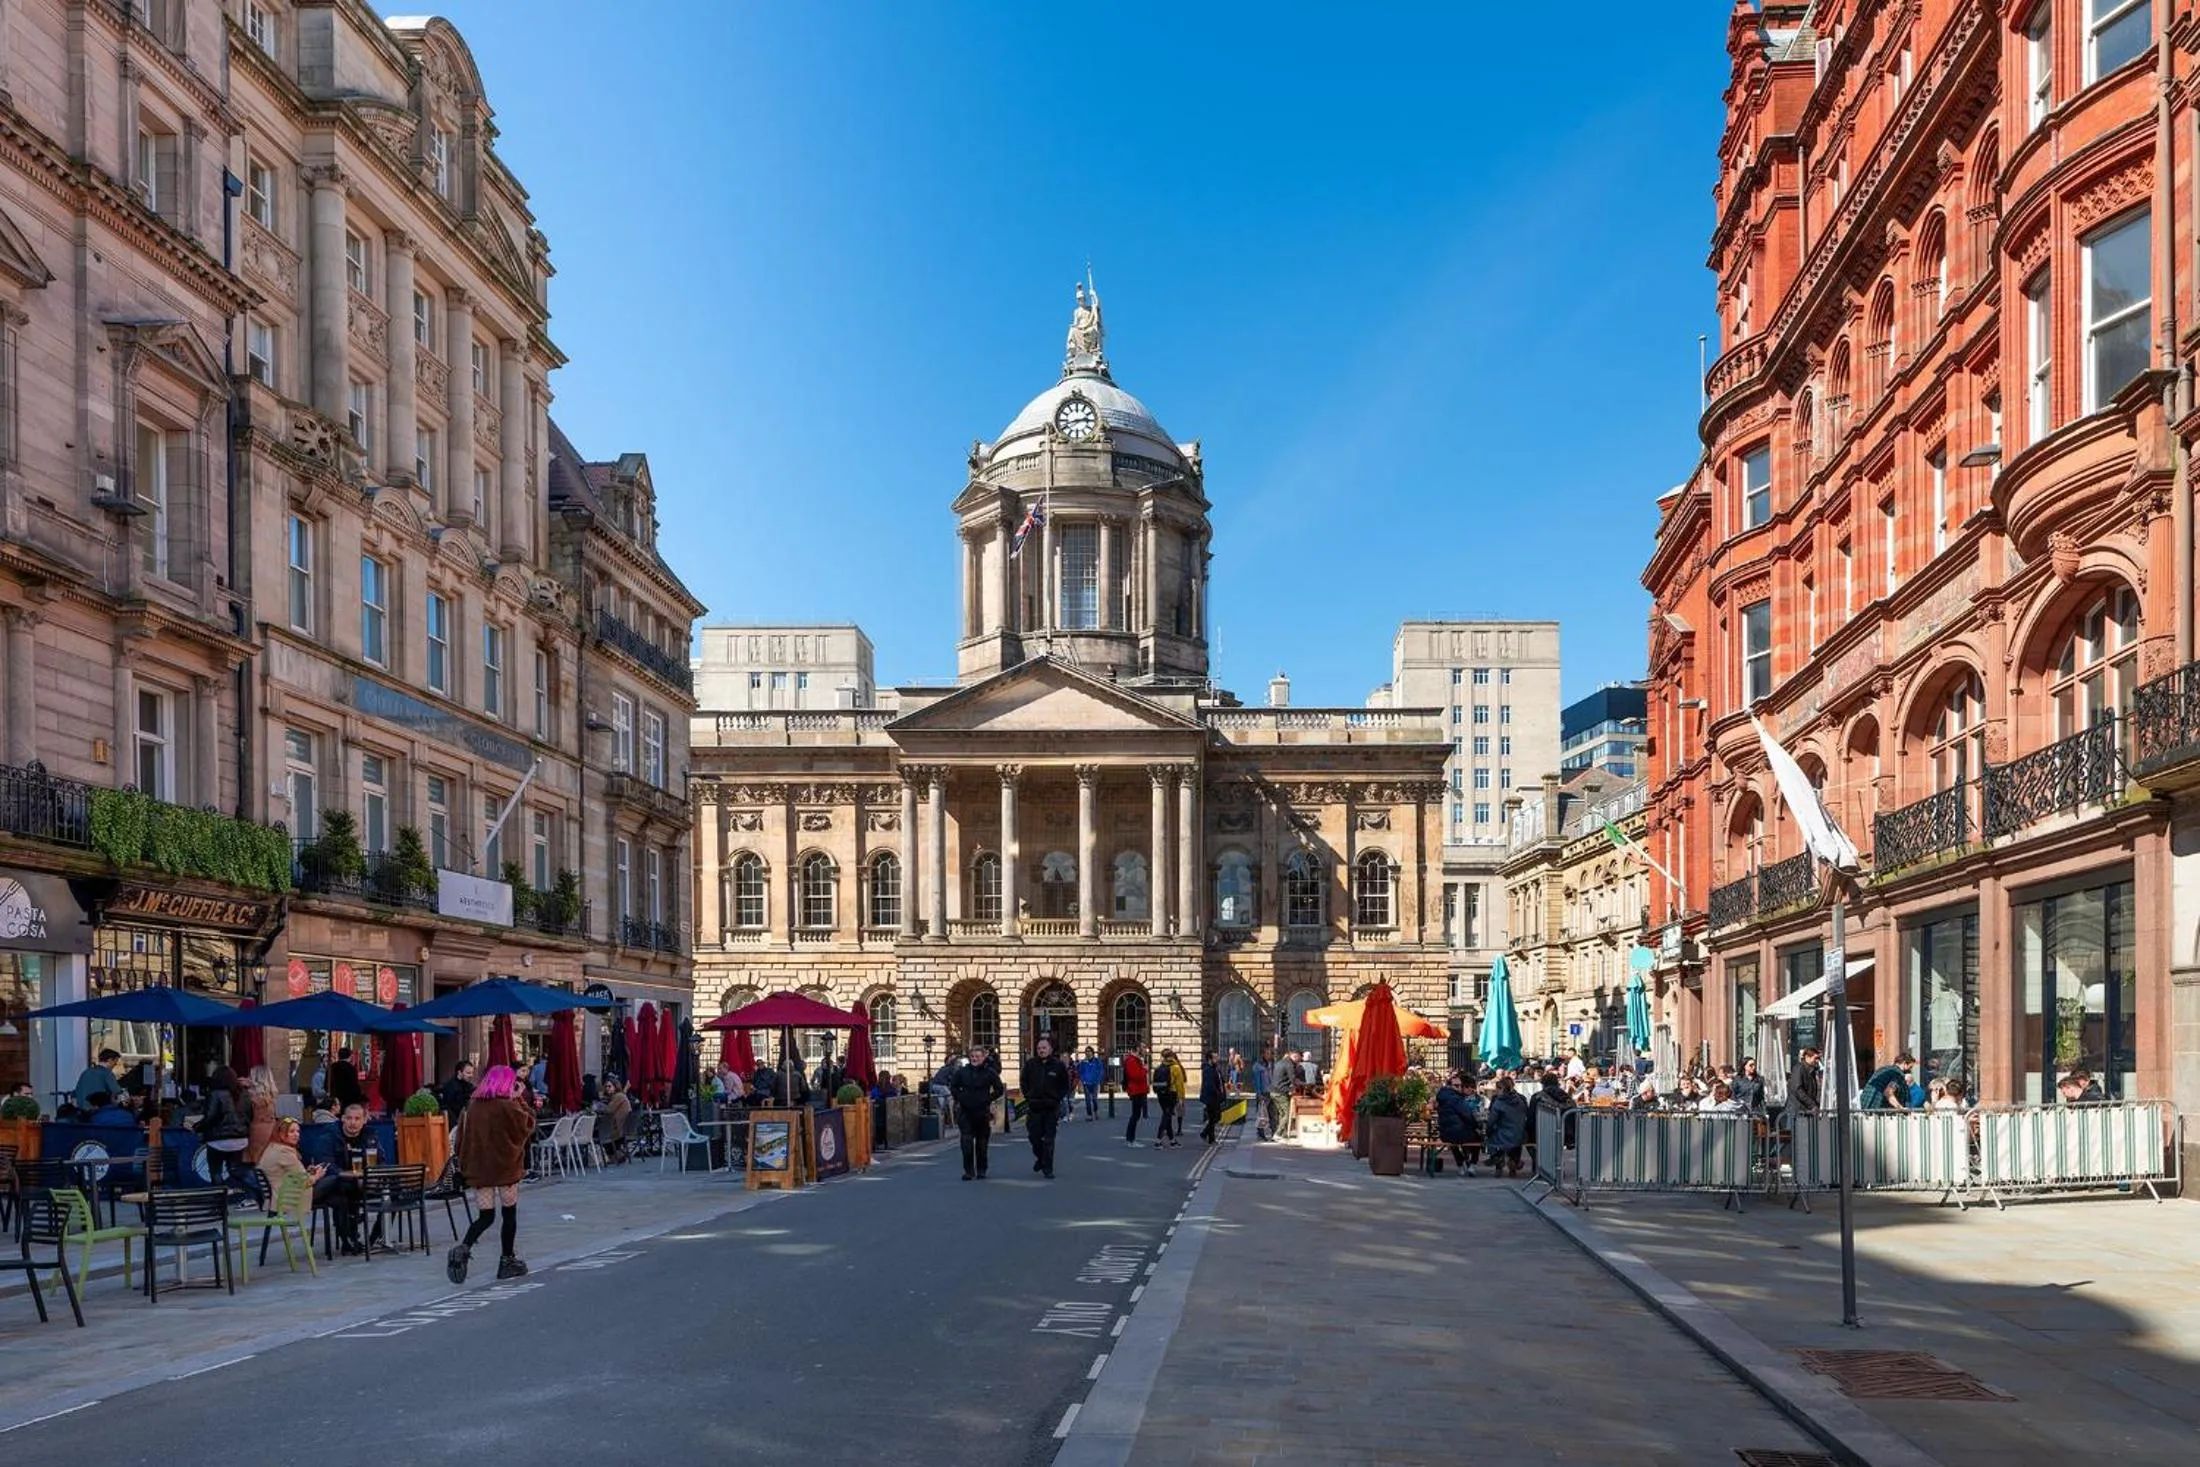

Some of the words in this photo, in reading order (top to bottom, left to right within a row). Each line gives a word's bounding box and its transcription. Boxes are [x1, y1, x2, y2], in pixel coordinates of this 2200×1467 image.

[7, 905, 47, 922] PASTA
[7, 922, 47, 938] COSA
[1075, 1244, 1149, 1284] LOADING
[333, 1283, 545, 1337] LOADING
[1031, 1302, 1113, 1338] ONLY
